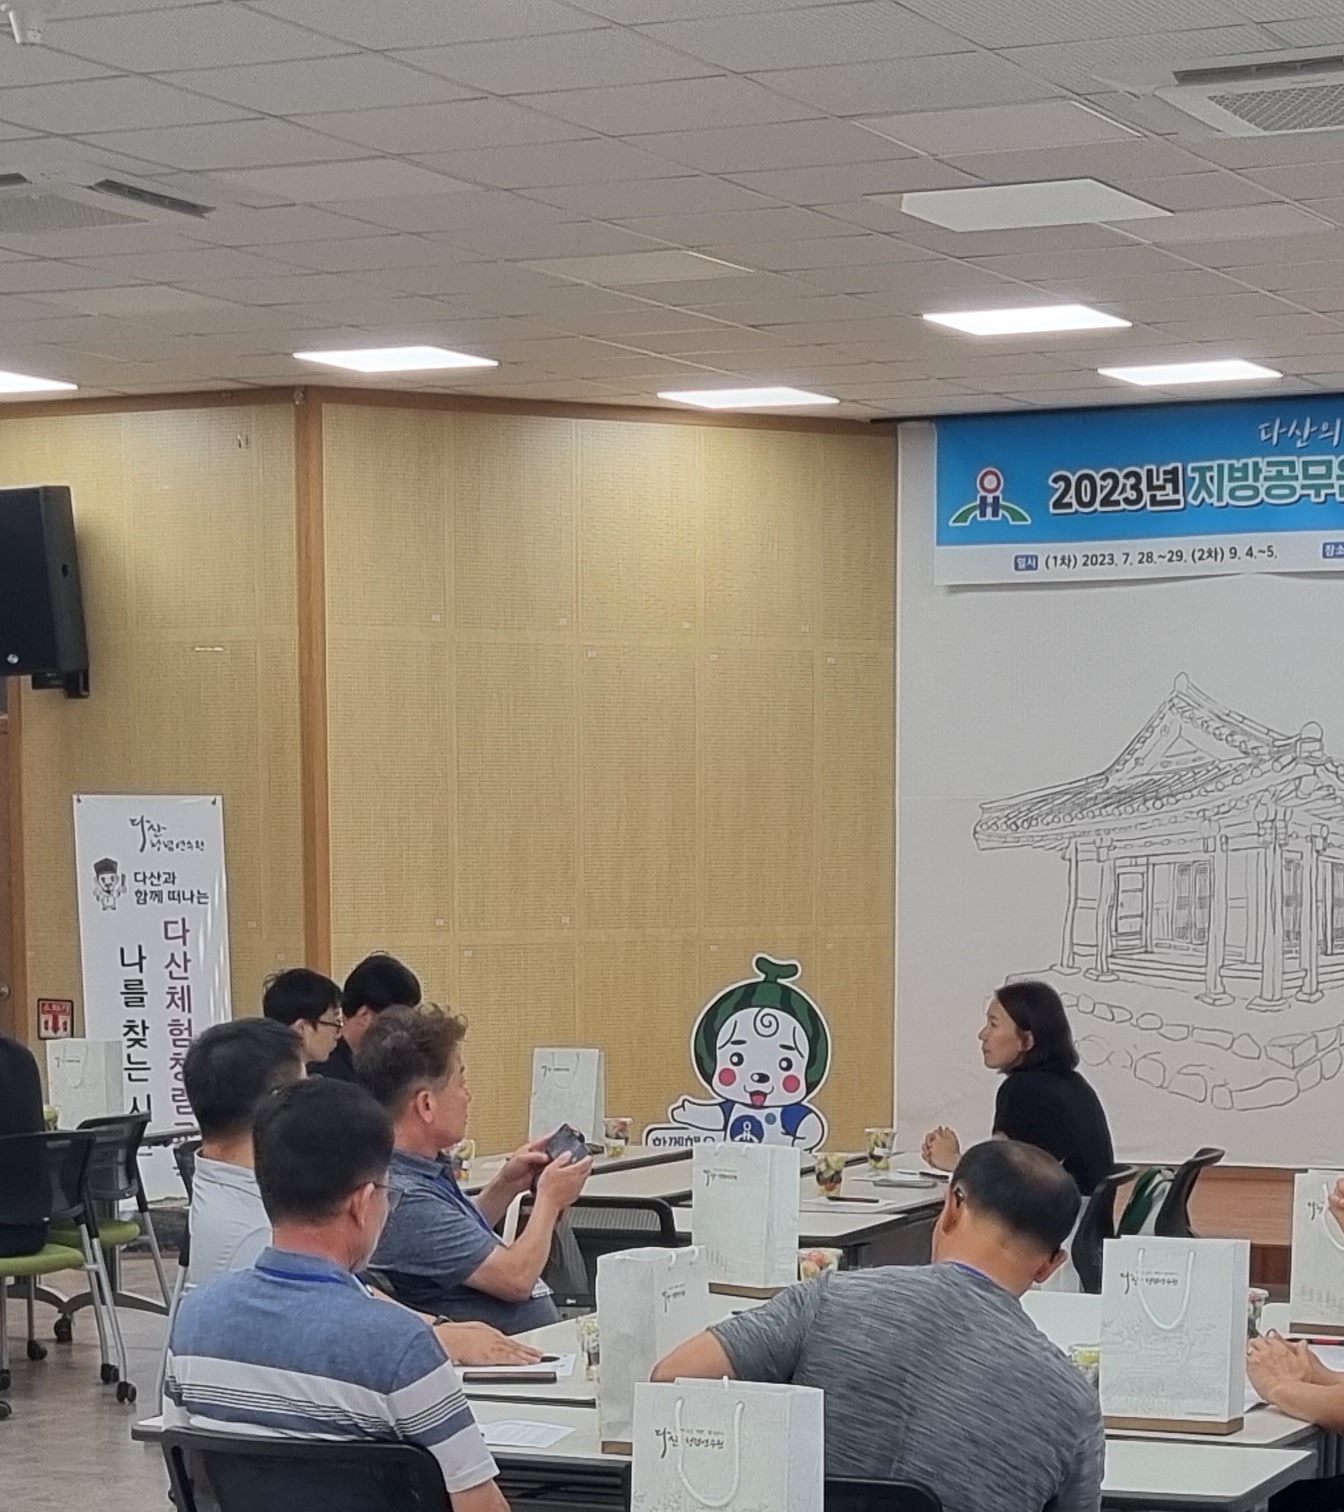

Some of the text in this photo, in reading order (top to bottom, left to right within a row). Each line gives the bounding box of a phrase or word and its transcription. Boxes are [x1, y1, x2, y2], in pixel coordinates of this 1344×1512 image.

[1258, 417, 1343, 449] 다산의
[1050, 463, 1184, 514] 2023년
[1044, 553, 1078, 570] (1차)
[1081, 553, 1119, 568] 2023.
[1122, 551, 1134, 567] 7.
[1137, 549, 1187, 566] 28.~29.
[1191, 547, 1225, 564] (2차)
[1229, 546, 1242, 561] 9.
[133, 870, 177, 887] 다산과
[134, 888, 210, 906] 함께 떠나는
[119, 943, 149, 1009] 나를
[122, 1018, 152, 1083] 찾는
